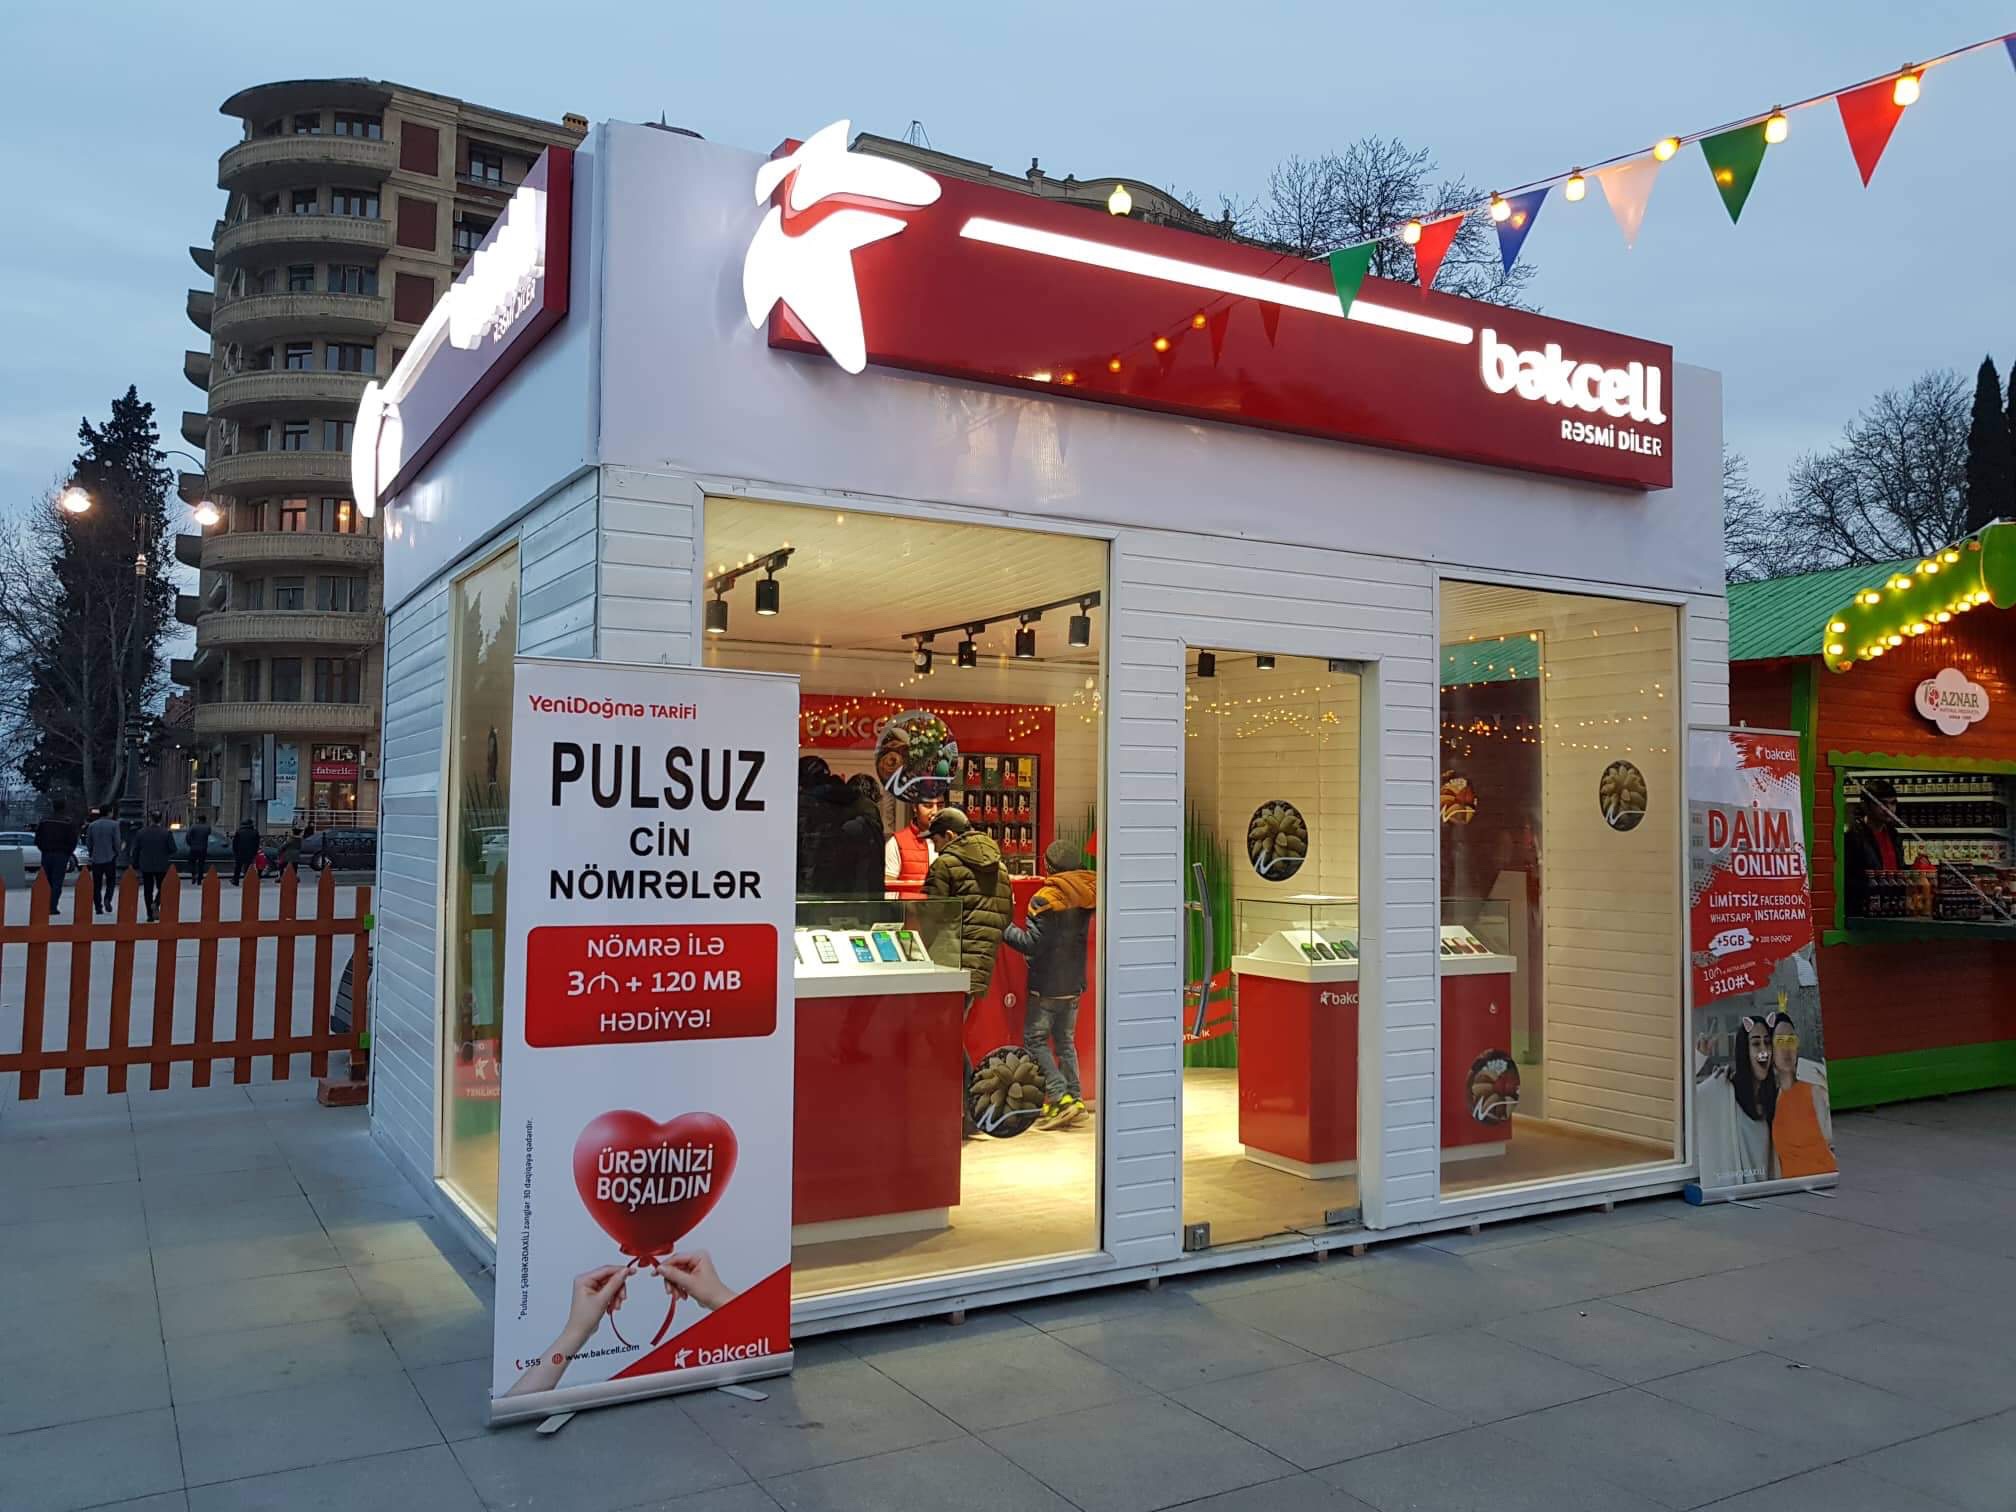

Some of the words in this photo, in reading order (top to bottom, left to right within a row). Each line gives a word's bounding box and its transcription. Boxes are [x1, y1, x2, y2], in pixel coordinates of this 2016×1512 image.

[1481, 328, 1666, 425] bakcell
[1560, 419, 1615, 448] RƏSMİ
[1618, 428, 1662, 456] DİLER
[528, 694, 645, 719] YeniDoğma
[648, 703, 697, 720] TARİFİ
[1940, 690, 1979, 708] AZNAR
[806, 711, 884, 738] bakce
[1764, 747, 1796, 761] bakcell
[551, 742, 766, 812] PULSUZ
[1708, 800, 1791, 851] DAİM
[629, 821, 690, 857] CİN
[1733, 853, 1800, 877] ONLINE
[550, 864, 762, 900] NÖMRƏLƏR
[1709, 890, 1759, 908] LİMİTSİZ
[1754, 908, 1806, 921] INSTAGRAM
[587, 934, 681, 958] NÖMRƏ
[688, 932, 725, 956] İLƏ
[1718, 934, 1745, 947] +5GB
[651, 971, 697, 993] 120
[703, 970, 742, 991] MB
[1332, 991, 1359, 1005] bakc
[599, 1006, 712, 1033] HƏDİYYƏ!
[598, 1141, 714, 1174] ÜRƏYİNİZİ
[596, 1173, 712, 1212] BOŞALDIN
[525, 1358, 541, 1368] 555
[565, 1344, 640, 1361] www.bakcell.com
[698, 1337, 770, 1365] bakcell
